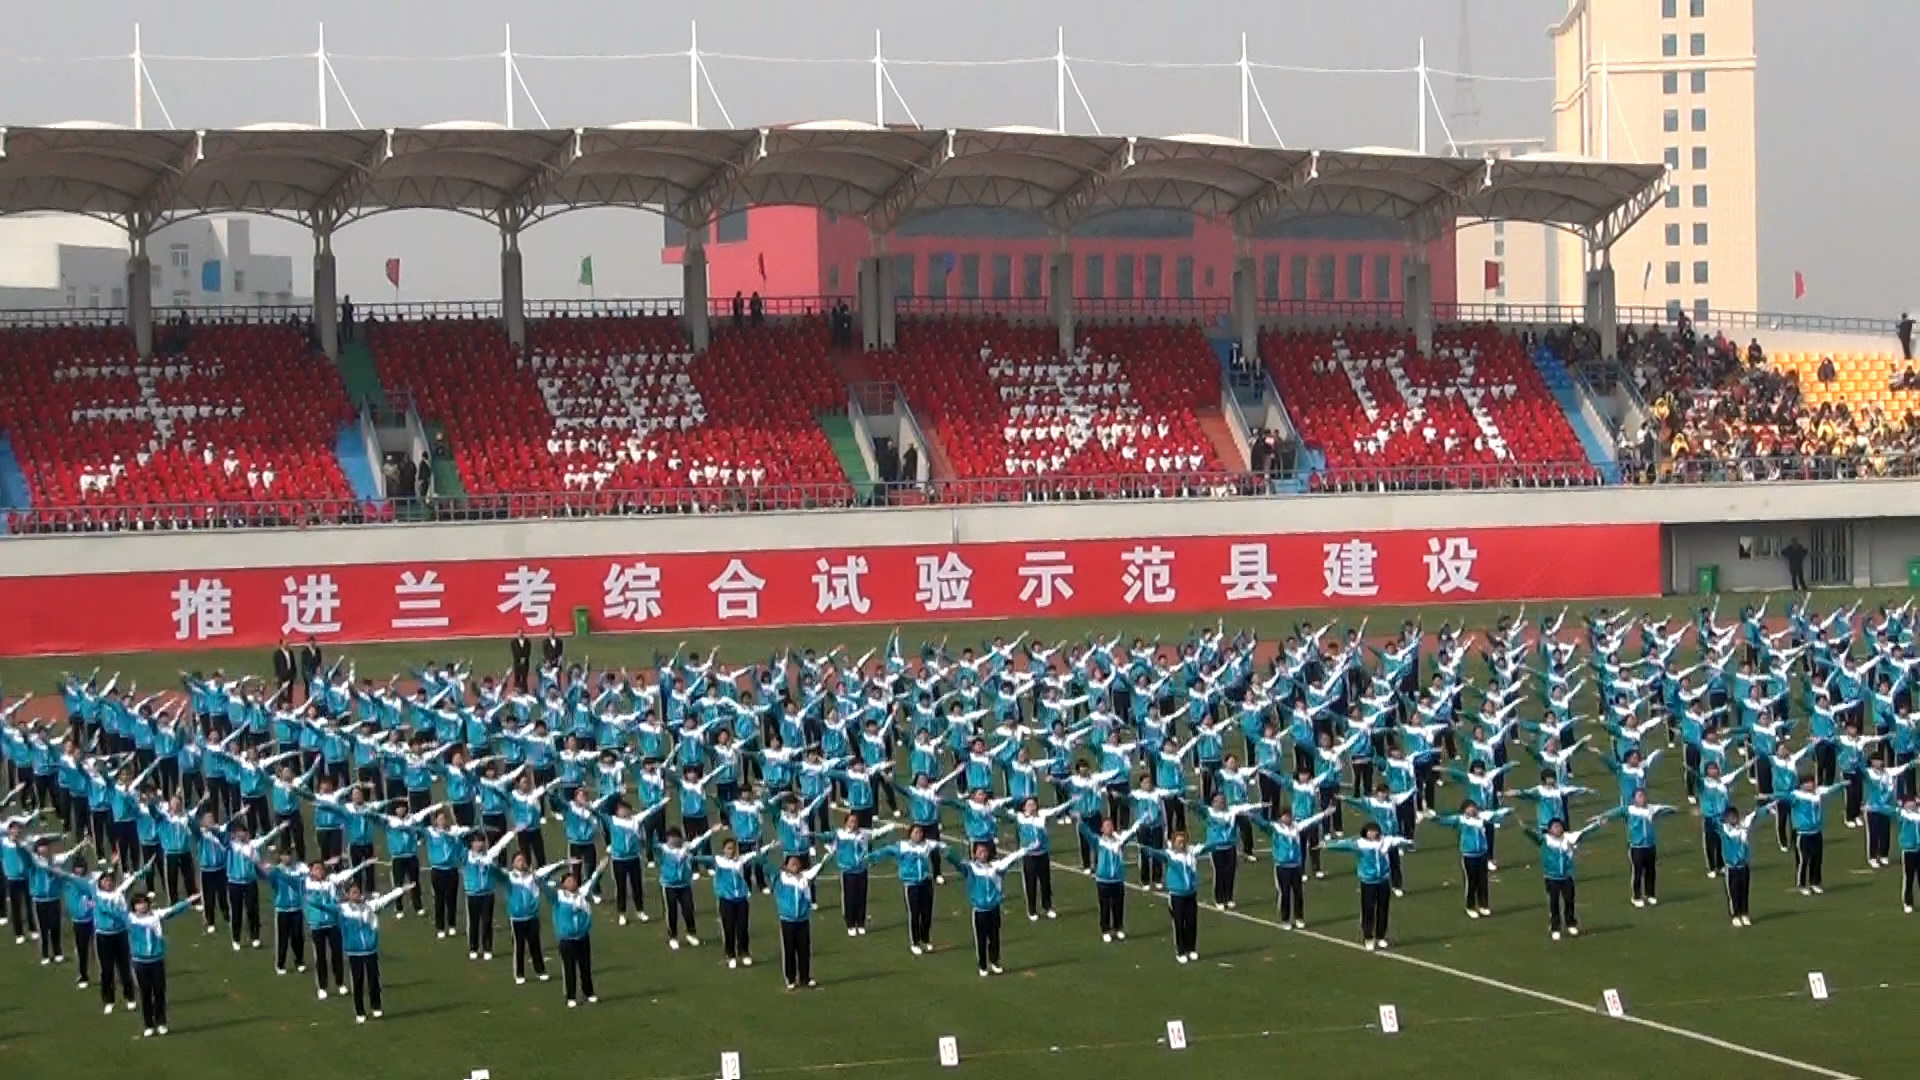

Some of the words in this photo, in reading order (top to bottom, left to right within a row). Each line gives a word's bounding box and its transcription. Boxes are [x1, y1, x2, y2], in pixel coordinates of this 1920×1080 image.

[171, 536, 1480, 641] 推进兰考综合试验示范县建设
[1811, 977, 1824, 995] 17
[1607, 993, 1620, 1011] 16
[1383, 1009, 1396, 1028] 15
[1171, 1026, 1184, 1045] 14
[942, 1042, 956, 1061] 13
[725, 1057, 738, 1078] 12
